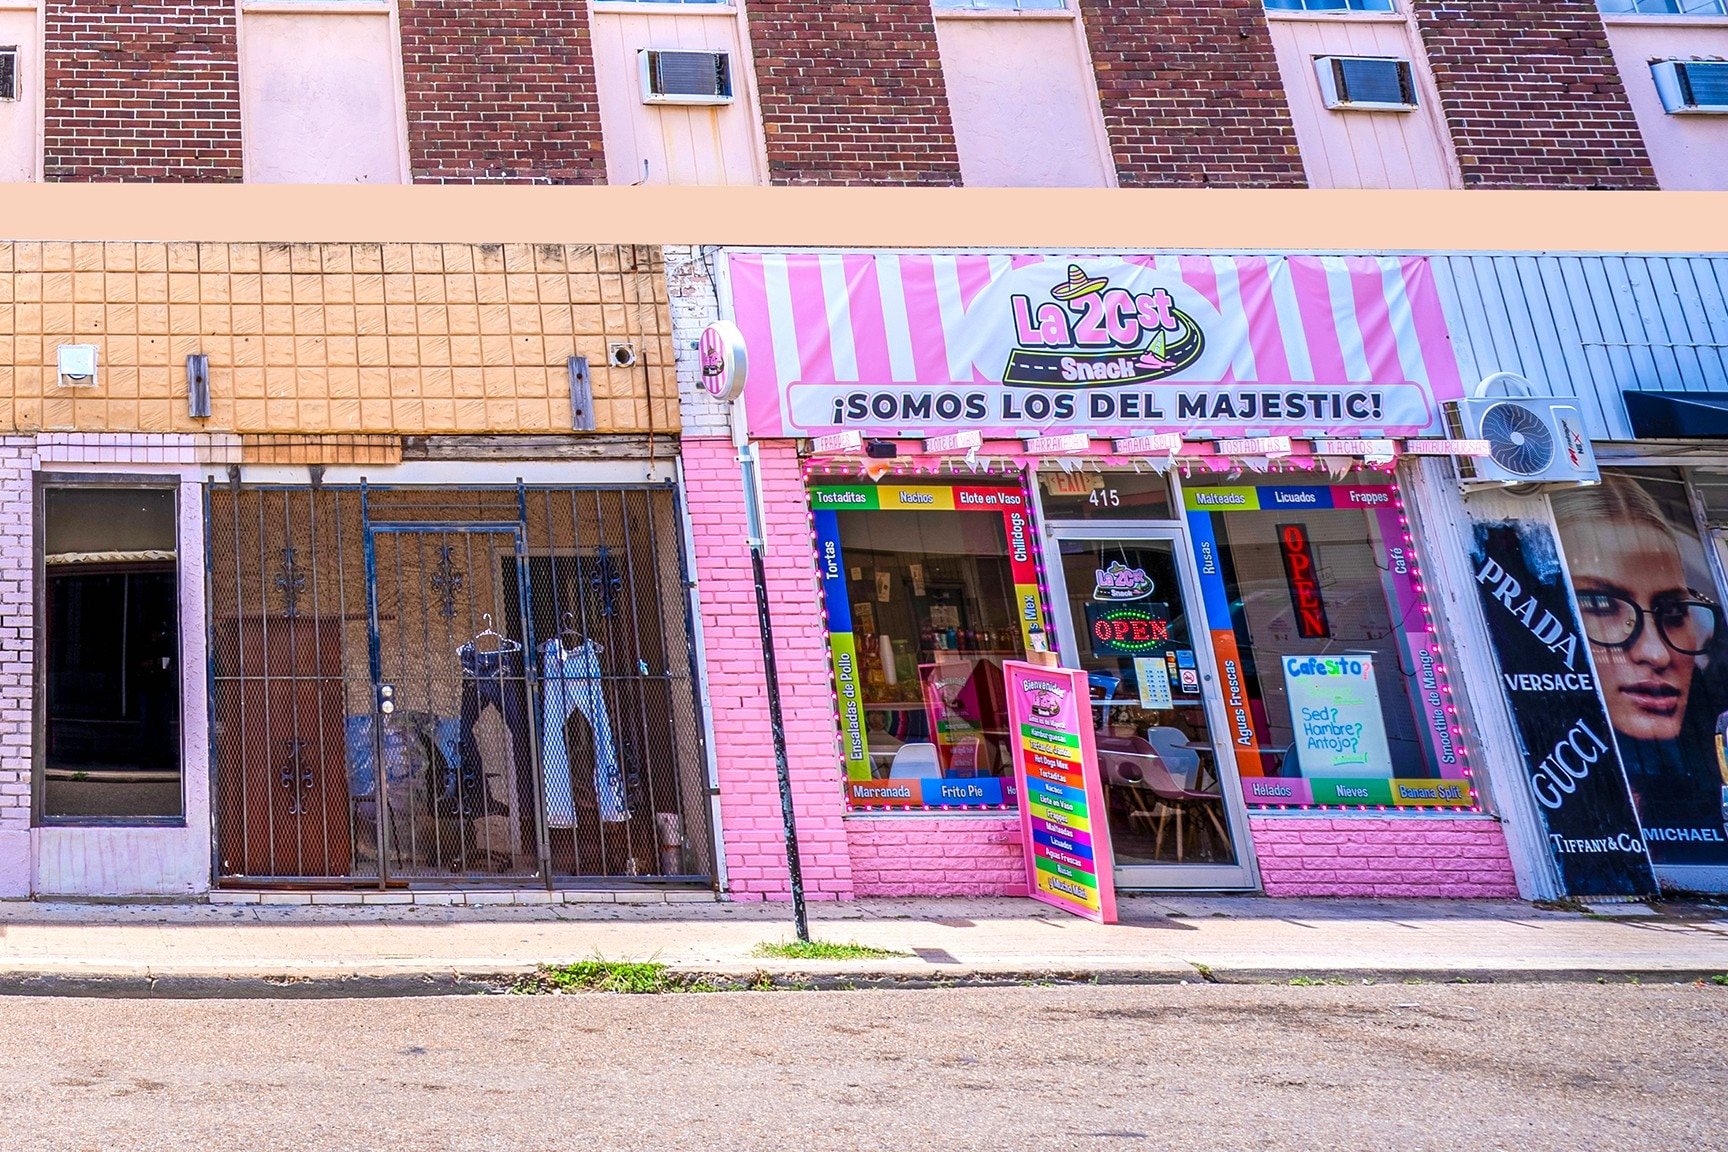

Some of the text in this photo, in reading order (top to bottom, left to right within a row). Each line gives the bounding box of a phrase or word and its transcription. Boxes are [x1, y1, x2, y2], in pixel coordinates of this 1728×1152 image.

[1012, 295, 1071, 348] La
[1060, 357, 1136, 381] Snack
[833, 392, 1384, 425] ¡SOMOS LOS DEL MAJESTIC!
[1117, 439, 1150, 452] BANANA
[1220, 439, 1281, 453] TOSTADITAS
[1327, 440, 1373, 454] NACHOS
[1407, 439, 1490, 454] HAMBURGUESAS
[1056, 472, 1087, 492] EXIT
[816, 491, 866, 504] Tostaditas
[900, 491, 933, 504] Nachos
[960, 492, 1021, 505] Elote en Vaso
[1089, 488, 1120, 507] 415
[1196, 492, 1246, 505] Malteadas
[1275, 491, 1316, 503] Licuados
[1349, 490, 1389, 505] Frappes
[1010, 512, 1028, 563] Chilidogs
[825, 540, 840, 580] Tortas
[1202, 541, 1216, 576] Rusas
[1394, 547, 1408, 575] Café
[1283, 527, 1327, 637] OPEN
[1024, 594, 1038, 621] Mex
[1475, 557, 1585, 671] PRADA
[1095, 620, 1168, 641] OPEN
[1504, 672, 1594, 691] VERSACE
[840, 652, 863, 761] Ensaladas de Pollo
[1224, 659, 1253, 747] Aguas Frescas
[1418, 648, 1455, 765] Smoothie de Mango
[1302, 706, 1339, 723] Sed?
[1303, 722, 1363, 739] Hambre?
[1307, 736, 1358, 753] Antojo?
[1531, 718, 1609, 809] GUCCI
[853, 785, 911, 799] Marranada
[941, 784, 983, 798] Frito Pie
[1252, 783, 1292, 797] Helados
[1336, 784, 1369, 798] Nieves
[1399, 786, 1462, 800] Banana Split
[1642, 827, 1724, 842] MICHAEL
